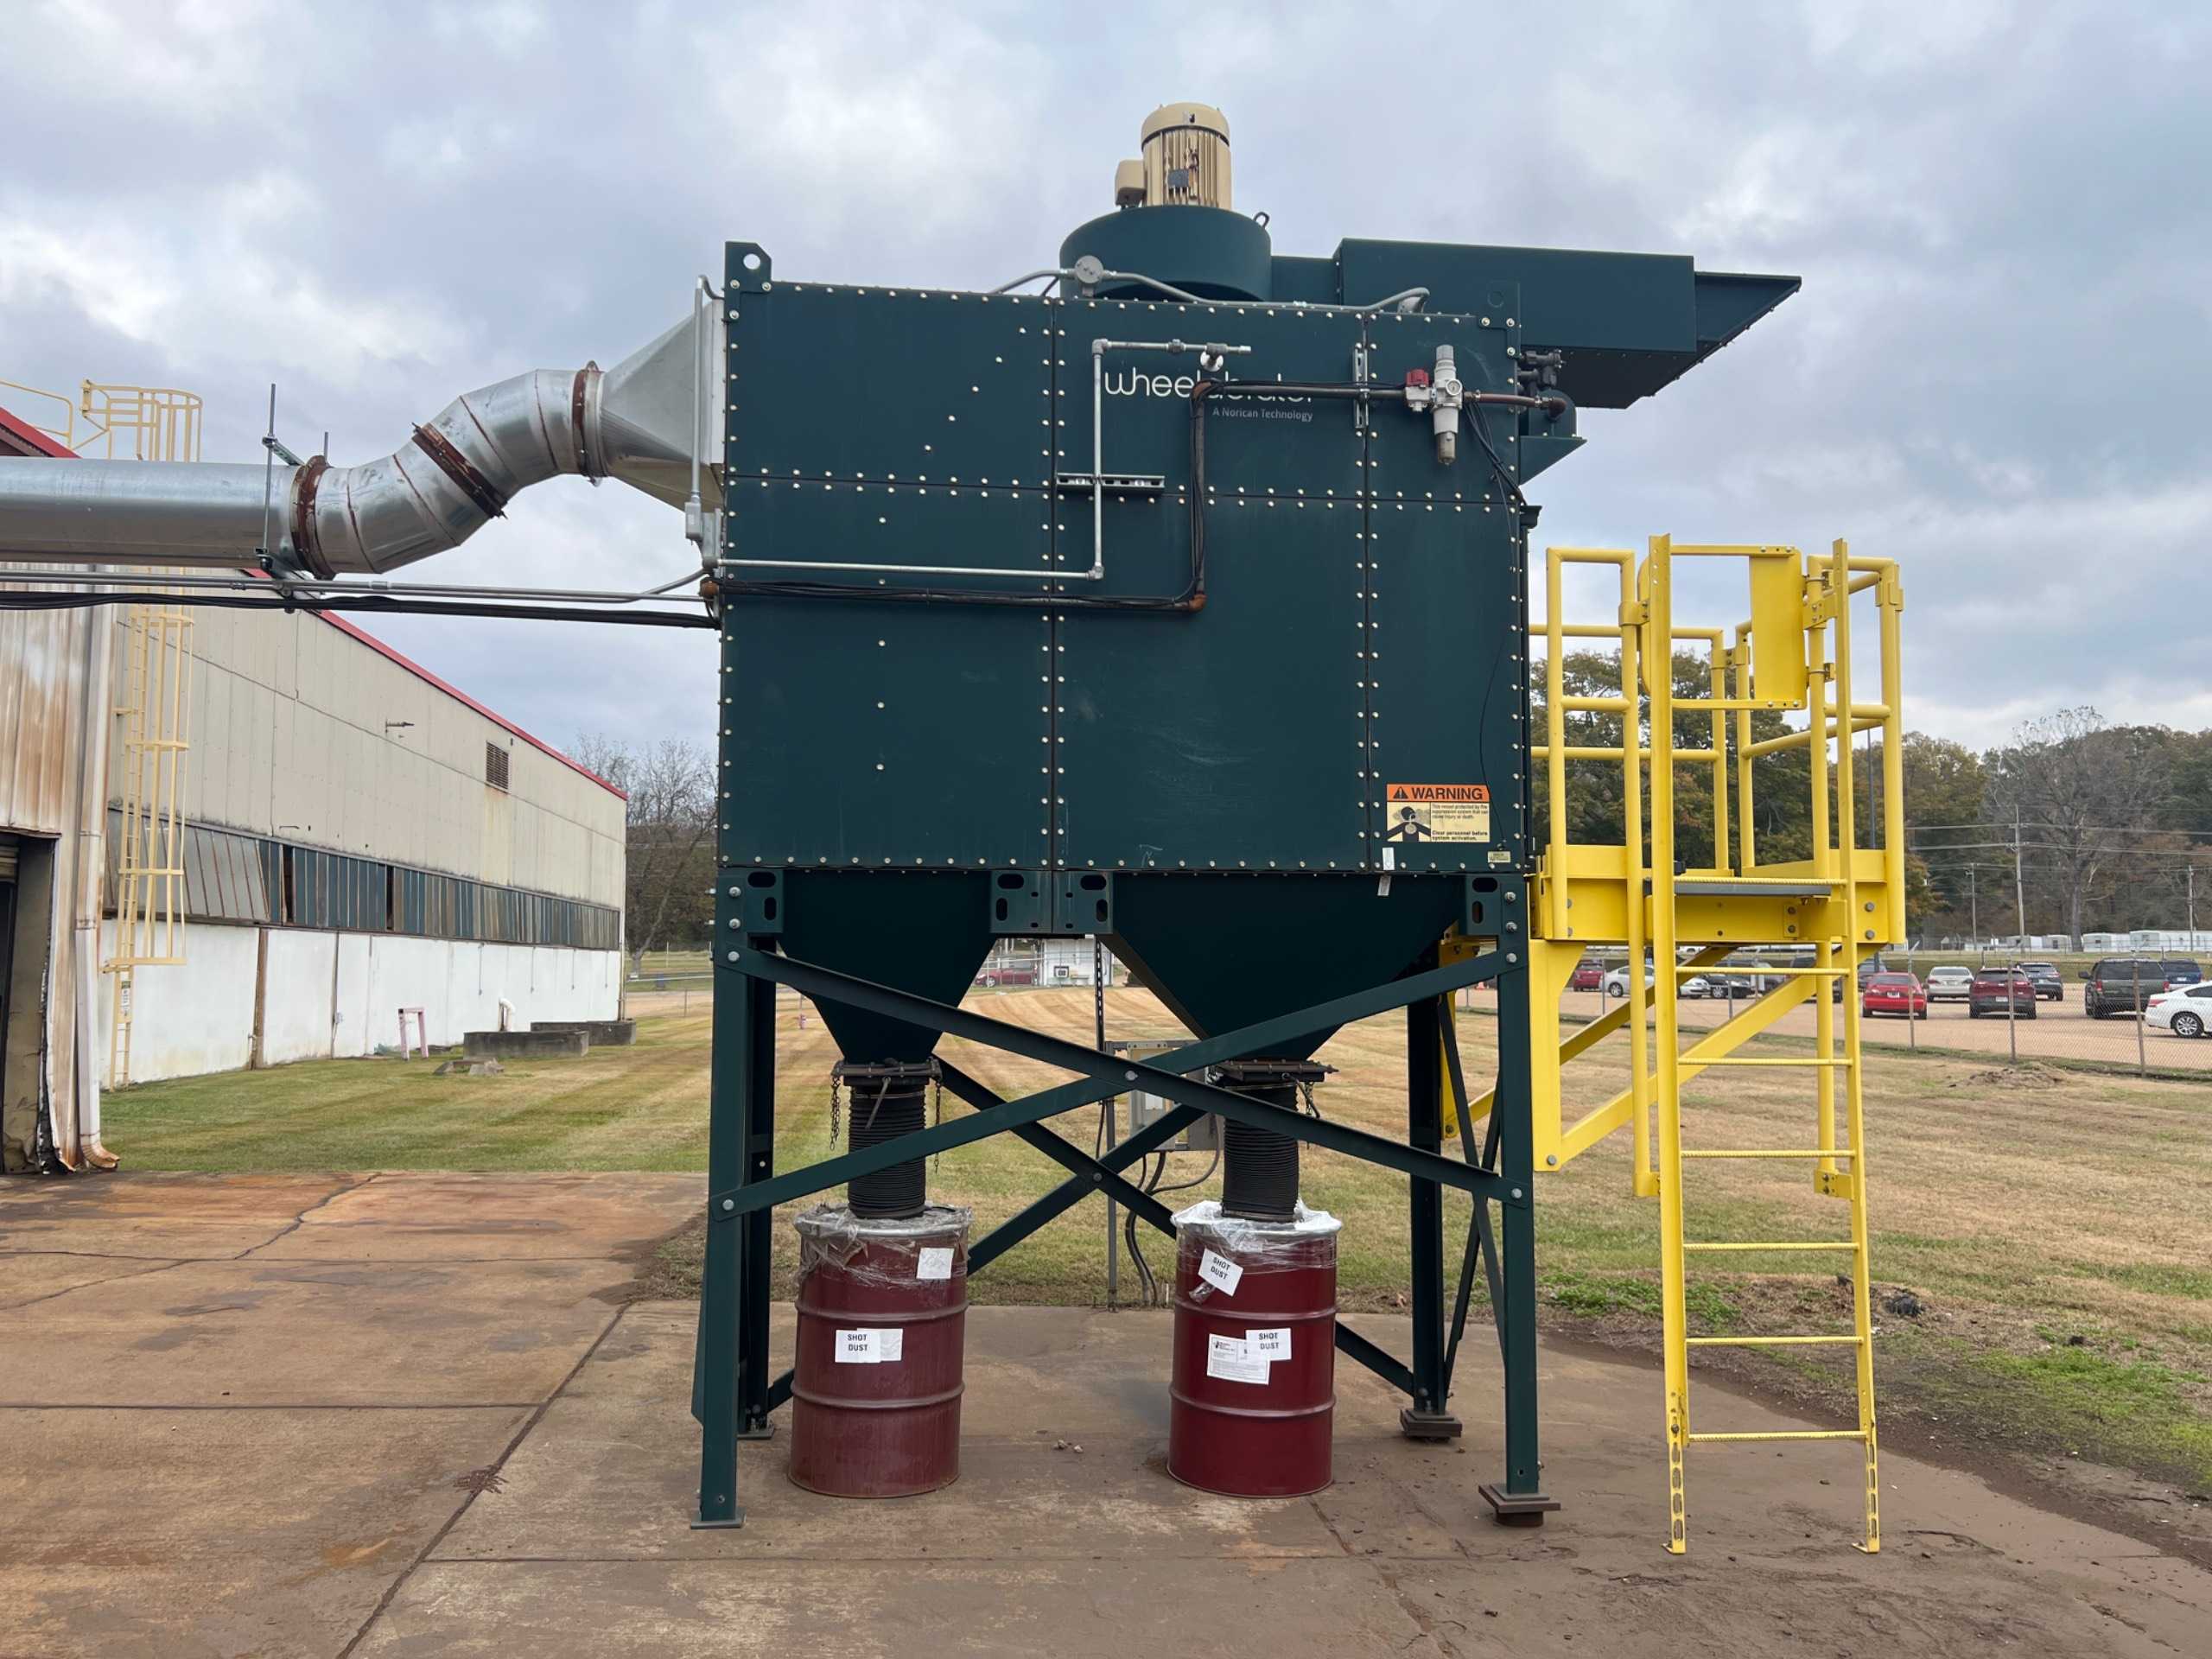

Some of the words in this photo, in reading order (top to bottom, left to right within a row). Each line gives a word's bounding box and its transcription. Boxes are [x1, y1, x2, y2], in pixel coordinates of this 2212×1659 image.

[1211, 407, 1220, 416] A
[1223, 407, 1258, 418] Norican
[1260, 408, 1313, 423] Technology
[1411, 787, 1483, 800] WARNING
[1212, 1257, 1230, 1270] SHOT
[1211, 1266, 1229, 1280] DUST
